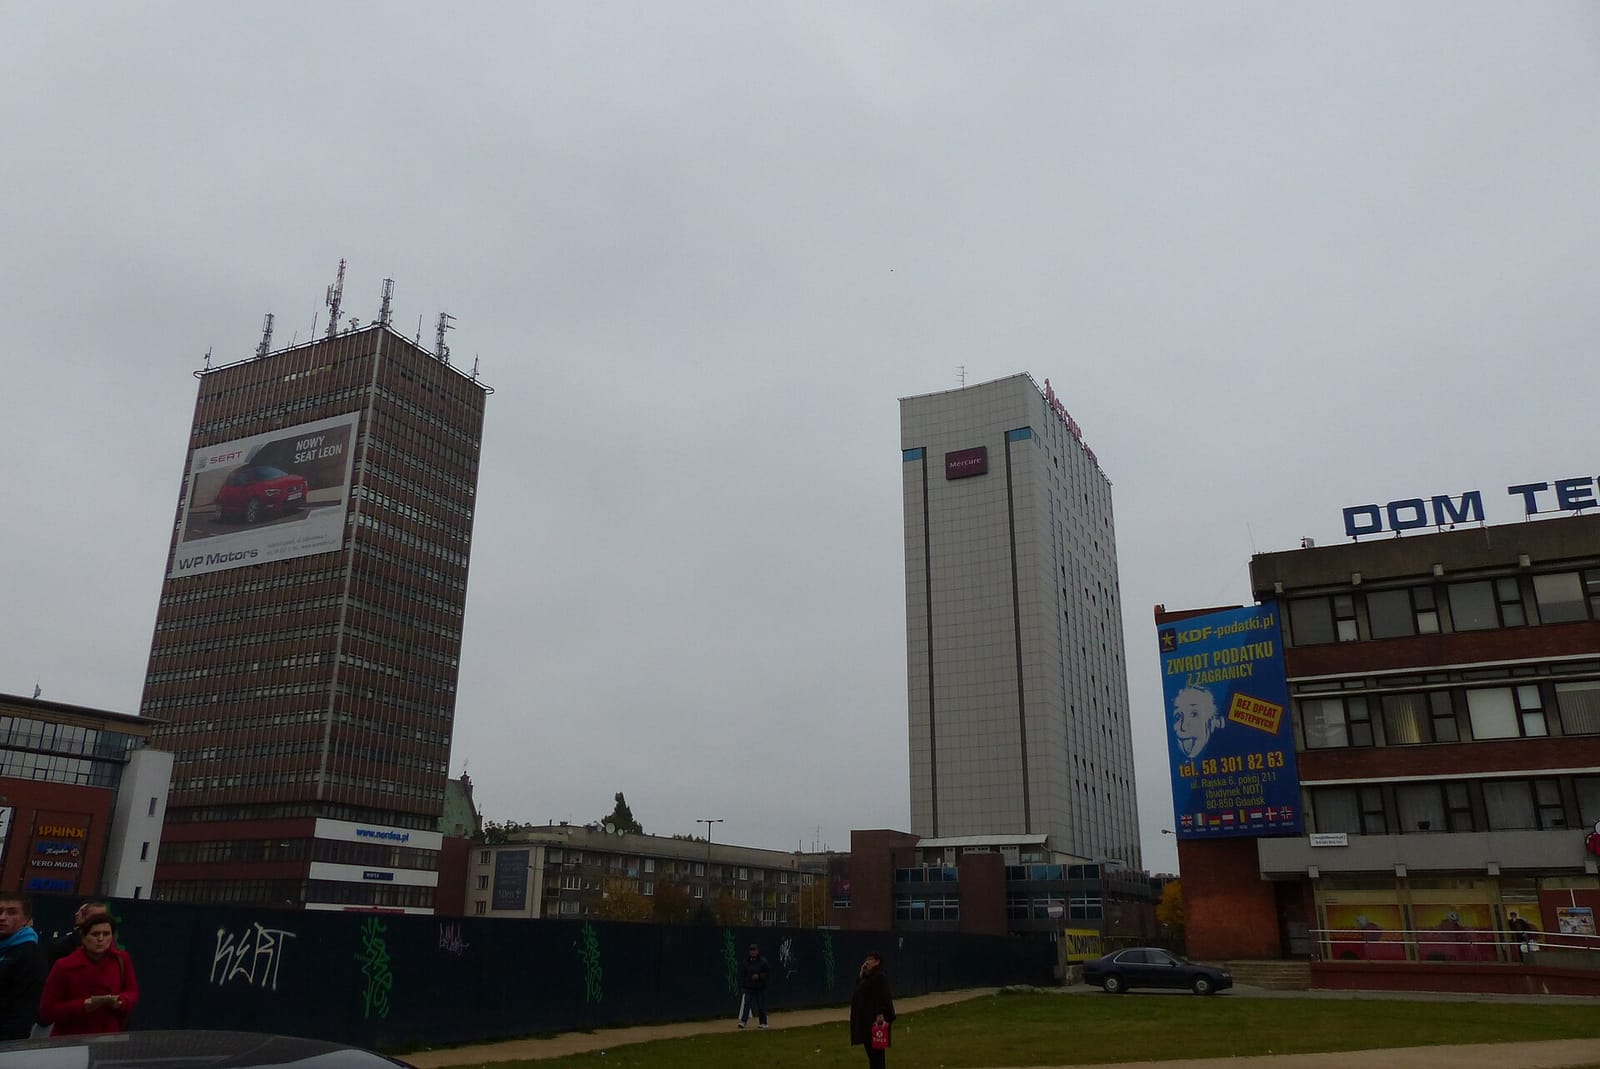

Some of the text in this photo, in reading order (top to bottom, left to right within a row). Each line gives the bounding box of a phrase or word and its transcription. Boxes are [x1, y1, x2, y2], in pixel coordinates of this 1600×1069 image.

[295, 435, 326, 451] NOWY
[210, 451, 243, 464] SEAT
[294, 444, 343, 464] SEAT LEON
[949, 457, 983, 469] Mercure
[1343, 476, 1600, 537] DOM TE
[179, 549, 259, 570] WP Motors
[1177, 613, 1274, 644] KDF-podatki.pl
[1167, 640, 1274, 675] ZWROT PODATKU
[1195, 663, 1254, 685] ZAGRANICY
[1236, 698, 1251, 711] BEZ
[1179, 751, 1284, 777] tel. 58 301 82 63
[1262, 771, 1277, 782] 211
[36, 824, 85, 839] SPHINX
[356, 828, 409, 843] www.nordea.pl
[31, 859, 78, 869] VERO MODA
